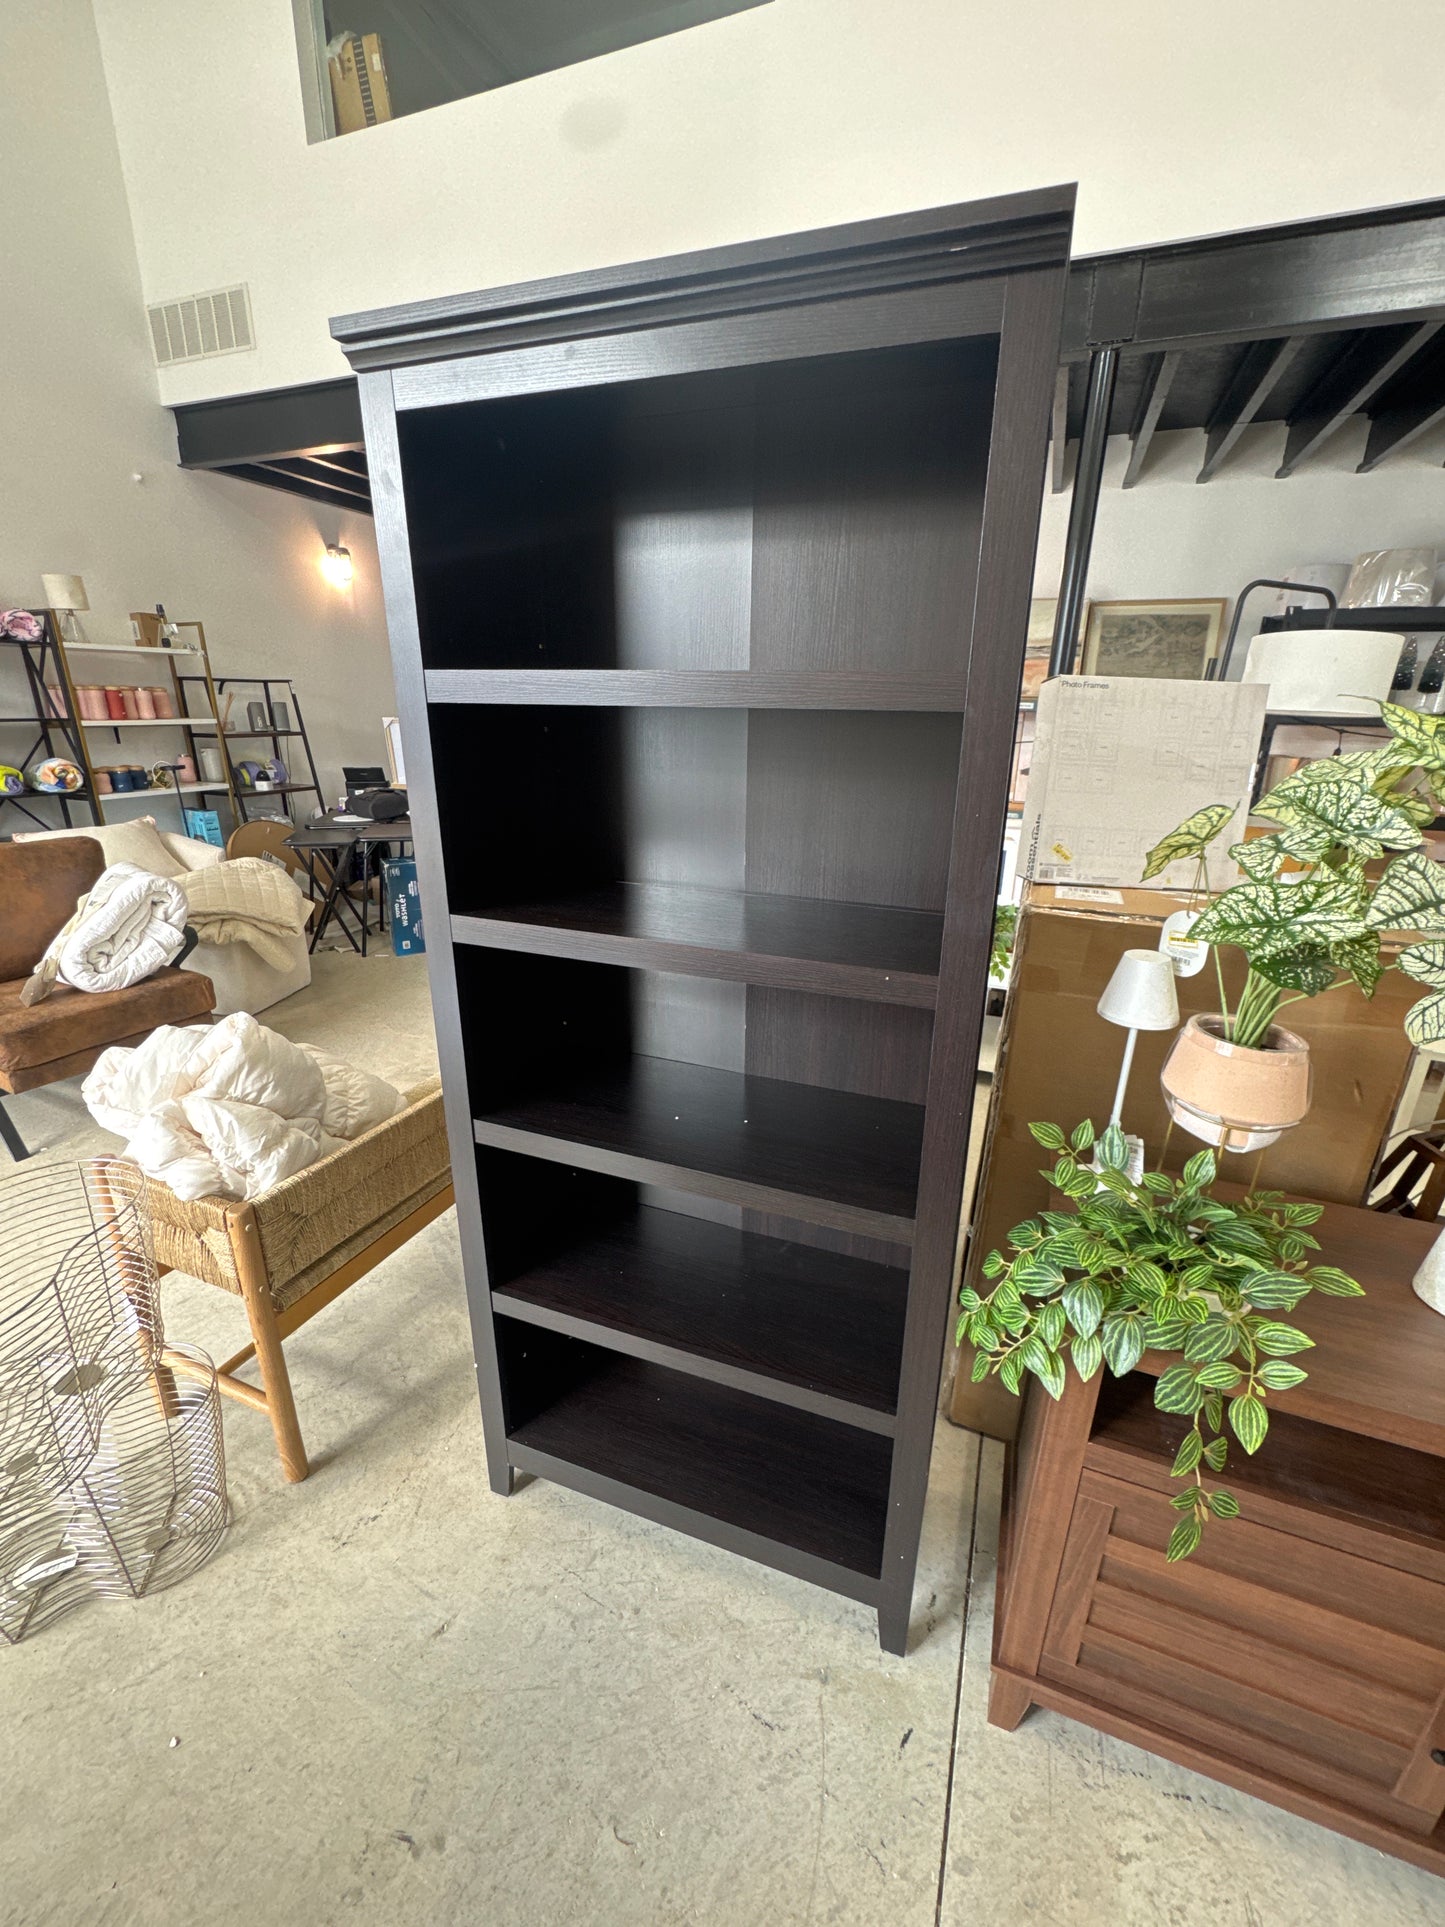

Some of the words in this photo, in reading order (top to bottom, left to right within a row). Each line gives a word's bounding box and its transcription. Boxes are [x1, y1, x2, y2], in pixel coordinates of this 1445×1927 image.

[1061, 680, 1083, 688] Photo
[1083, 681, 1110, 690] Frames
[1026, 843, 1035, 879] room
[1029, 813, 1042, 879] essentials
